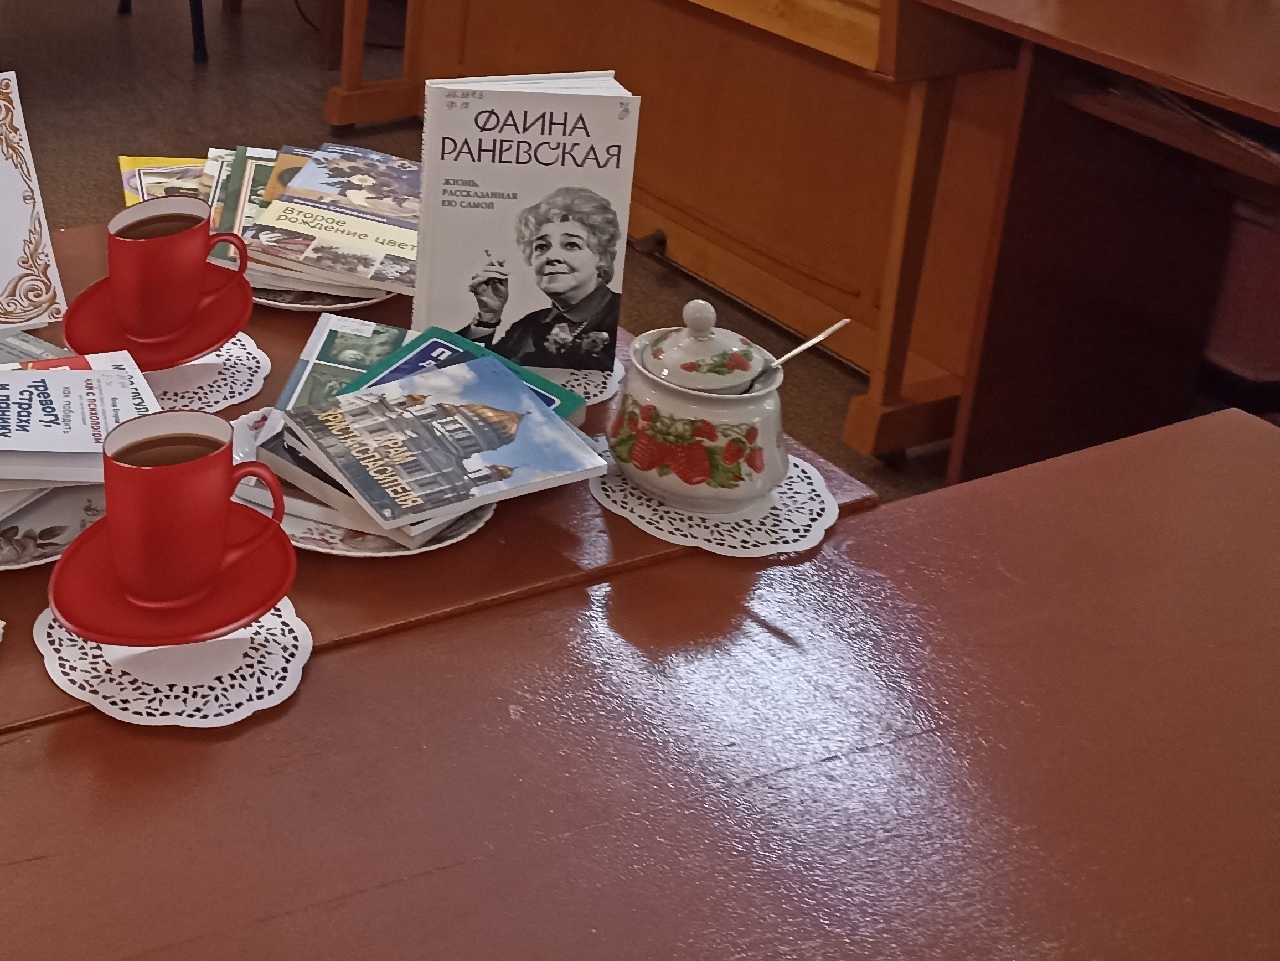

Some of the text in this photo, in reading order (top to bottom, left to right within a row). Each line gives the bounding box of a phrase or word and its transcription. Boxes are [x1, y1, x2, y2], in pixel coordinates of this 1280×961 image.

[473, 108, 591, 138] ФАИНА
[440, 136, 622, 170] РАНЕВСКАЯ
[275, 214, 418, 252] рождение цвет
[282, 206, 347, 227] Второе
[11, 389, 34, 433] страхи
[27, 378, 61, 427] тревогу,
[62, 386, 75, 435] как победить
[86, 398, 104, 444] ПСИХОЛОГОМ
